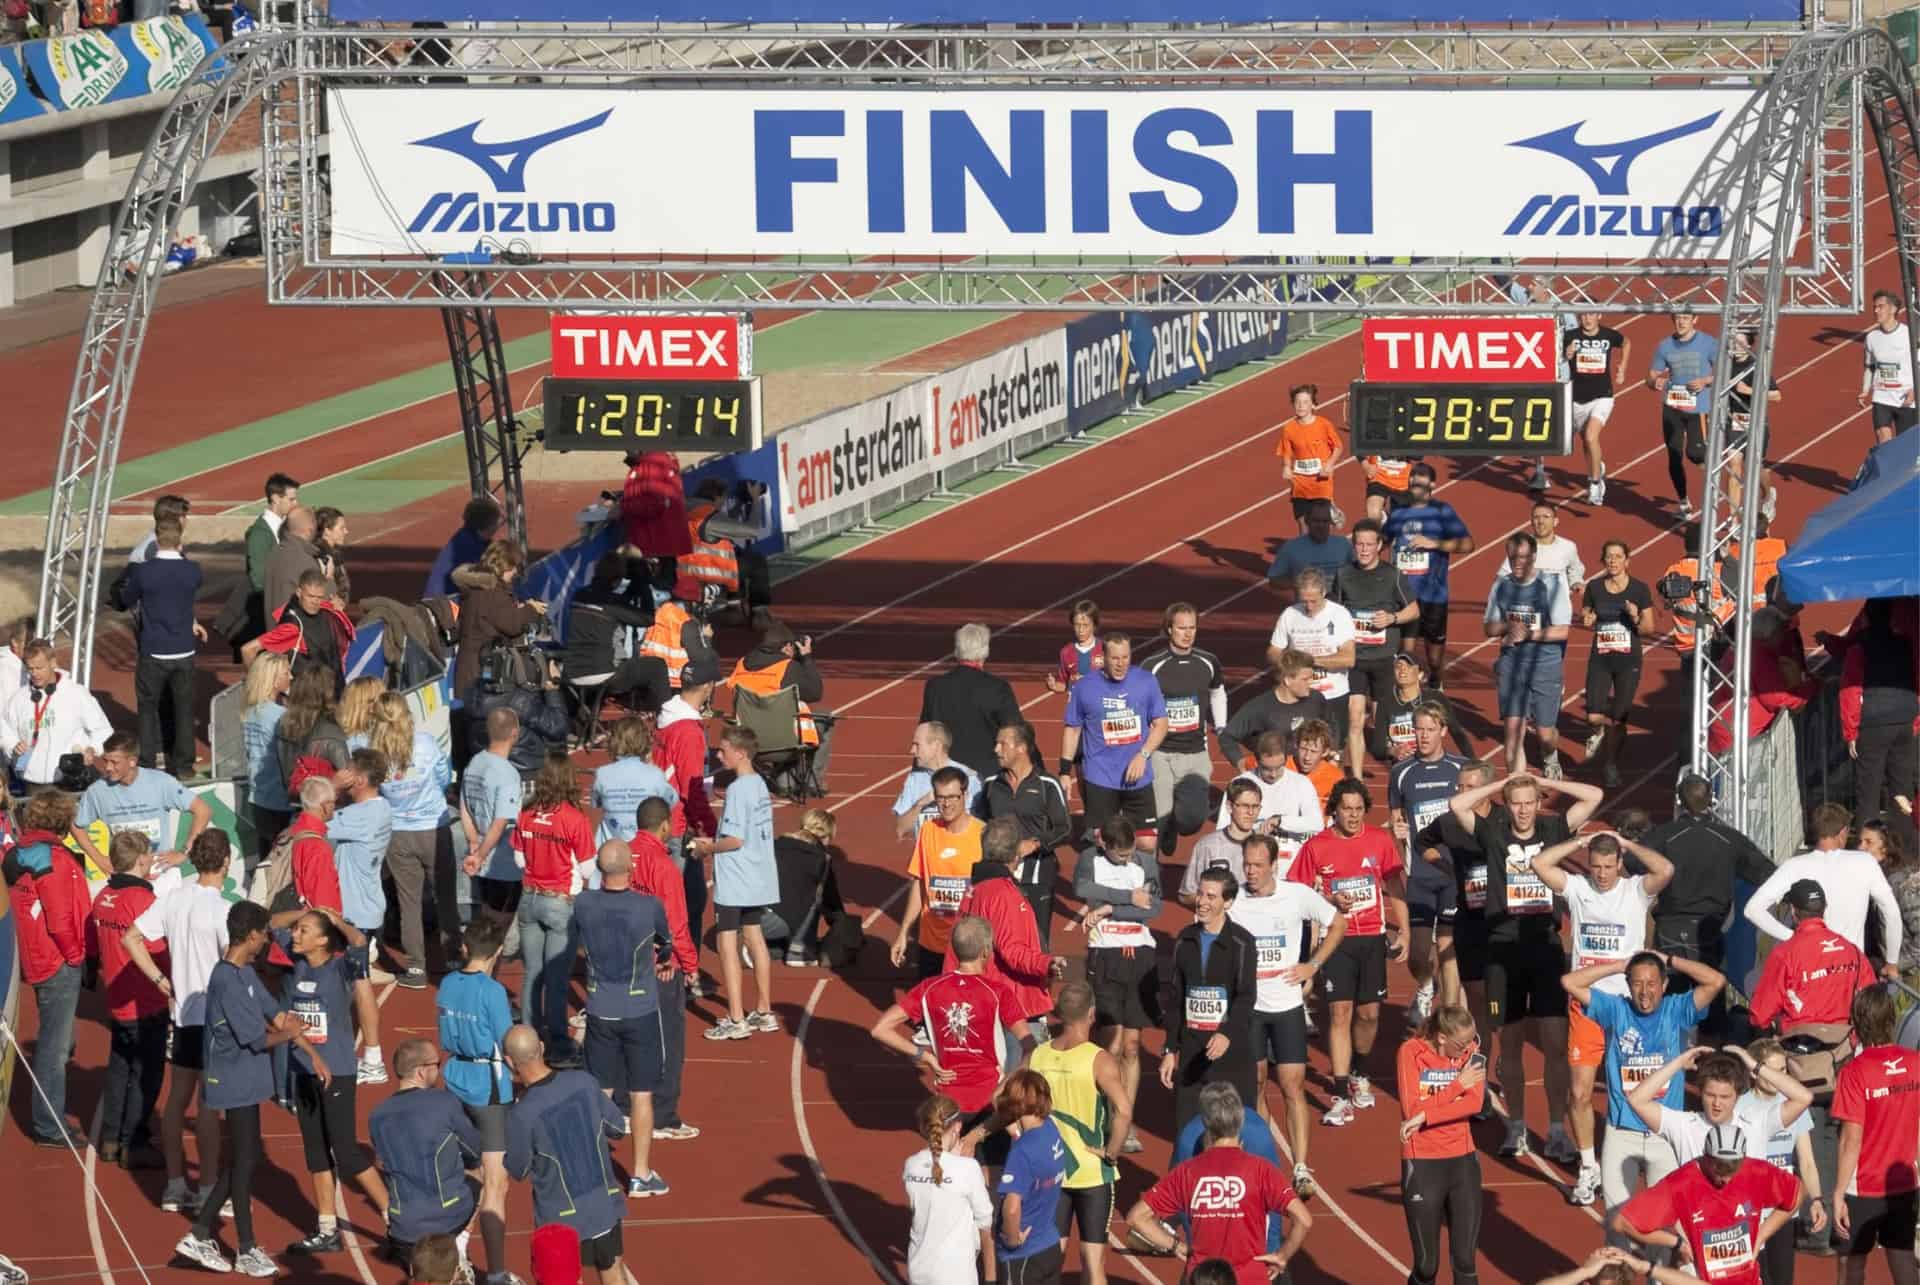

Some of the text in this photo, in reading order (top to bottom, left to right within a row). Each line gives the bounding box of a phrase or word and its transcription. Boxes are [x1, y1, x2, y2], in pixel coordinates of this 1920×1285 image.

[69, 37, 112, 80] AA
[754, 107, 1373, 235] FINISH
[406, 192, 616, 233] MIZUNO
[1503, 195, 1722, 237] MIZUNO
[560, 328, 729, 367] TIMEX
[1373, 331, 1546, 369] TIMEX
[576, 394, 740, 436] 1:20:14
[932, 347, 1061, 456] I amsterdam
[797, 401, 924, 509] amsterdam
[1188, 999, 1223, 1014] 42054
[1190, 1176, 1247, 1210] ADP
